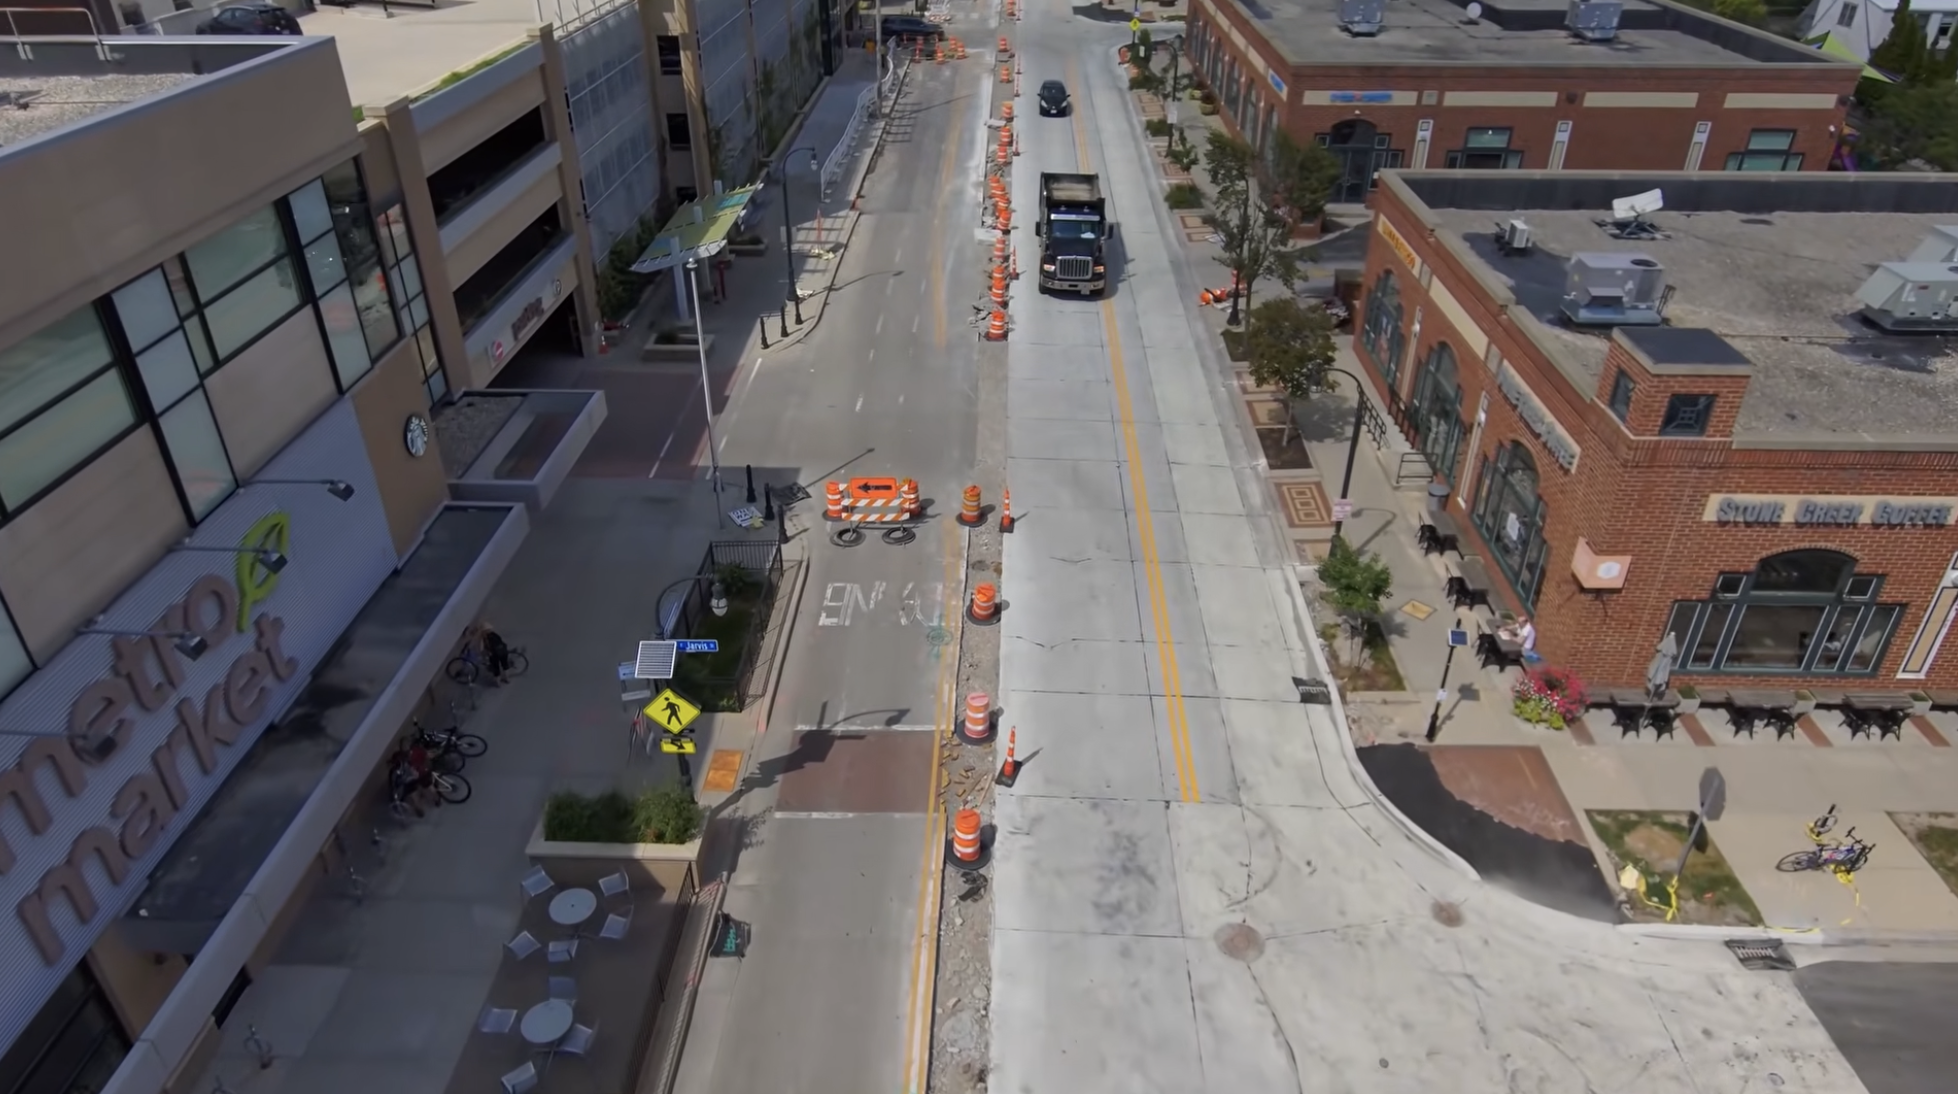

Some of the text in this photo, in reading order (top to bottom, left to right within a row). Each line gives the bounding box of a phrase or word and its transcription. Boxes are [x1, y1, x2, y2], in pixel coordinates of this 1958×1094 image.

[1717, 497, 1953, 527] STONE CREEK COFFEE
[0, 574, 237, 876] metro
[685, 641, 708, 650] Jarvis
[17, 612, 298, 968] market
